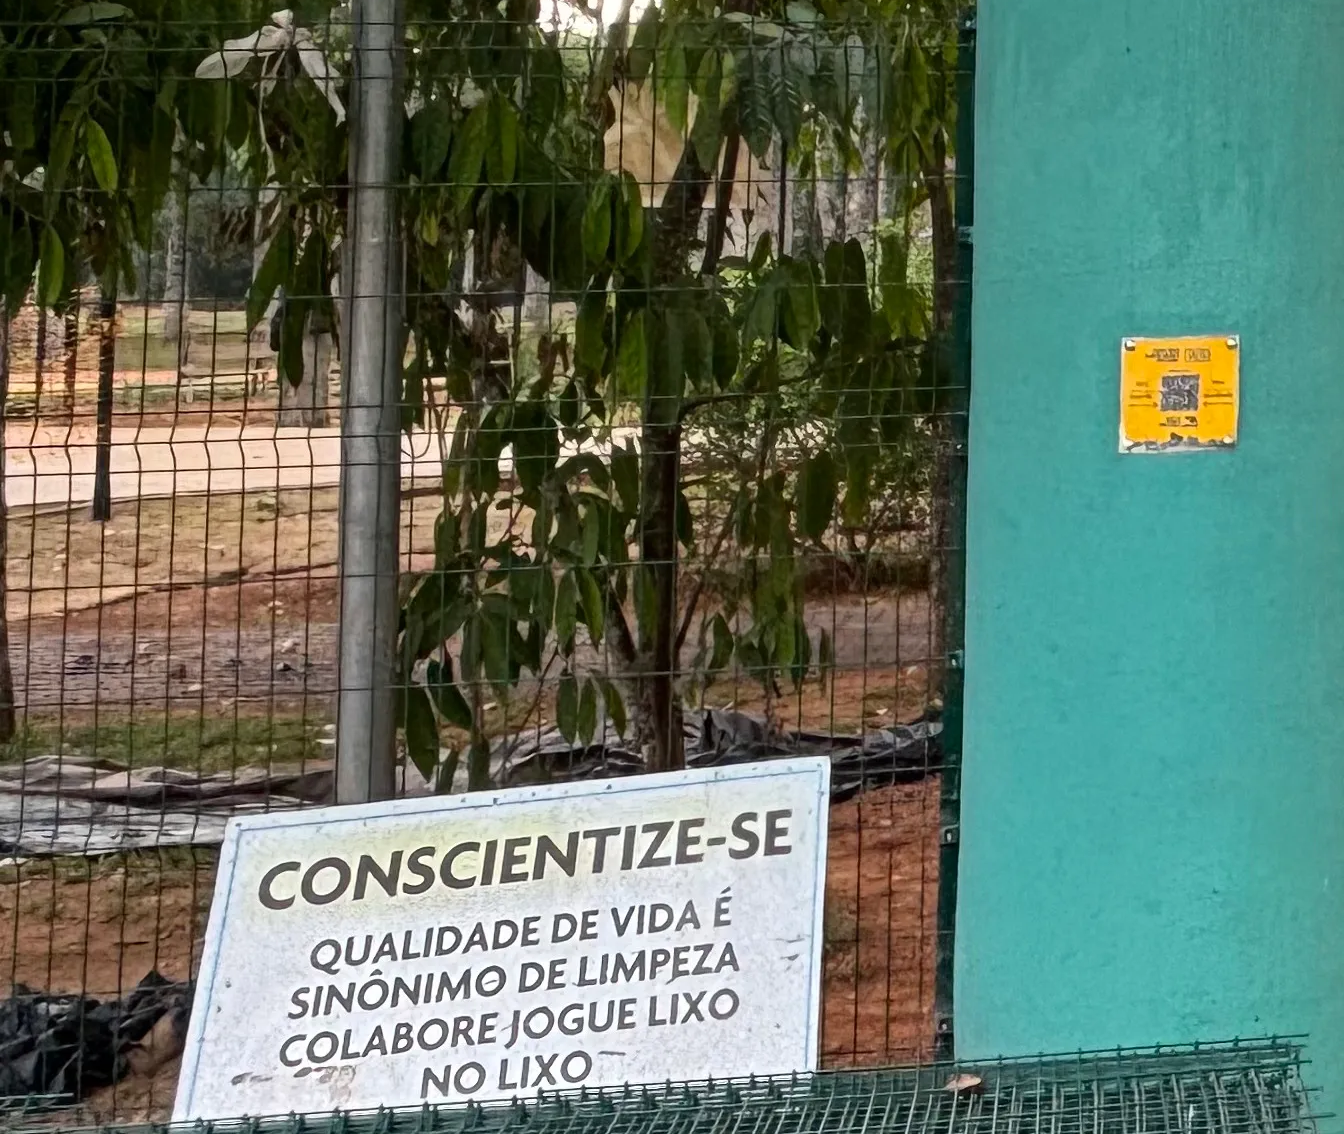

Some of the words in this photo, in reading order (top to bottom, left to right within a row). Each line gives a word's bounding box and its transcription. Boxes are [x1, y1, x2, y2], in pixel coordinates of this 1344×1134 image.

[257, 808, 793, 911] CONSCIENTIZE-SE
[310, 915, 541, 976] QUALIDADE
[551, 909, 599, 944] DE
[610, 900, 701, 937] VIDA
[714, 887, 733, 927] É
[287, 965, 507, 1020] SINÔNIMO
[518, 958, 567, 993] DE
[577, 942, 740, 990] LIMPEZA
[278, 1012, 499, 1068] COLABORE
[503, 998, 637, 1050] JOGUE
[648, 988, 741, 1027] LIXO
[420, 1061, 486, 1099] NO
[498, 1050, 593, 1090] LIXO
